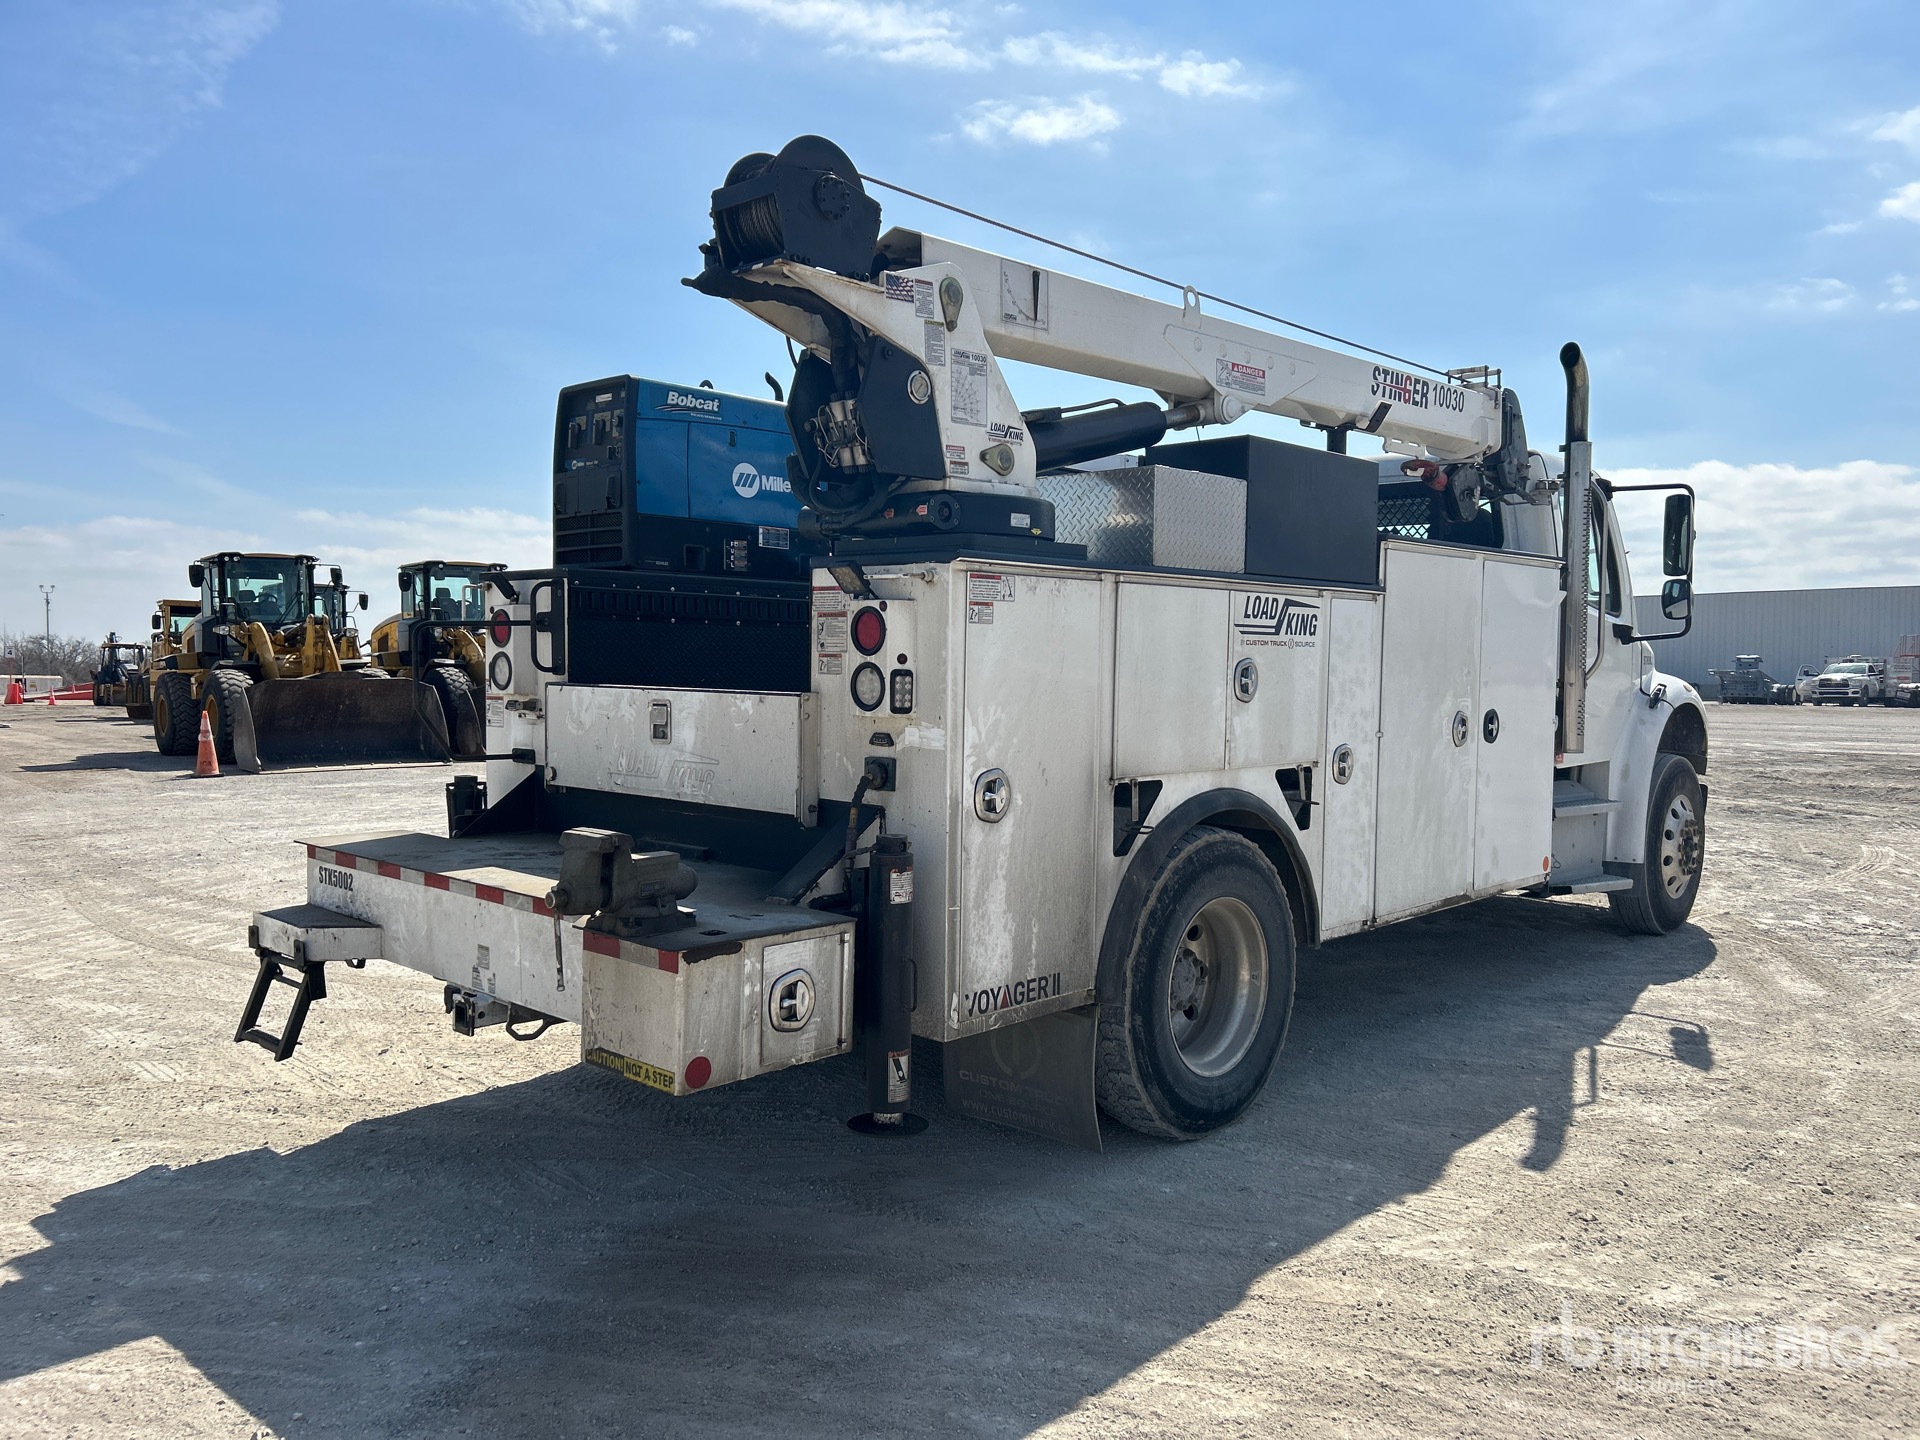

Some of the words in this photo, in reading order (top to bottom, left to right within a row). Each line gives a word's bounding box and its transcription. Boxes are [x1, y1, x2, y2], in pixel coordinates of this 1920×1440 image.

[971, 353, 987, 363] 10030
[1238, 364, 1264, 378] DANGER
[1371, 365, 1430, 409] STINGER
[1433, 383, 1465, 413] 10030
[667, 390, 720, 412] Bobcat
[990, 422, 1006, 433] LOAD
[1008, 430, 1024, 441] KING
[761, 474, 793, 494] Mille
[1244, 595, 1279, 620] LOAD
[1285, 612, 1318, 637] KING
[1295, 640, 1315, 648] SOURCE
[318, 865, 354, 891] STK5002
[965, 976, 1049, 1017] VOYAGER
[586, 1048, 624, 1072] CAUTION!
[625, 1060, 643, 1078] NOT
[644, 1068, 651, 1081] A
[652, 1070, 674, 1088] STEP
[959, 1070, 1022, 1094] CUSTOM
